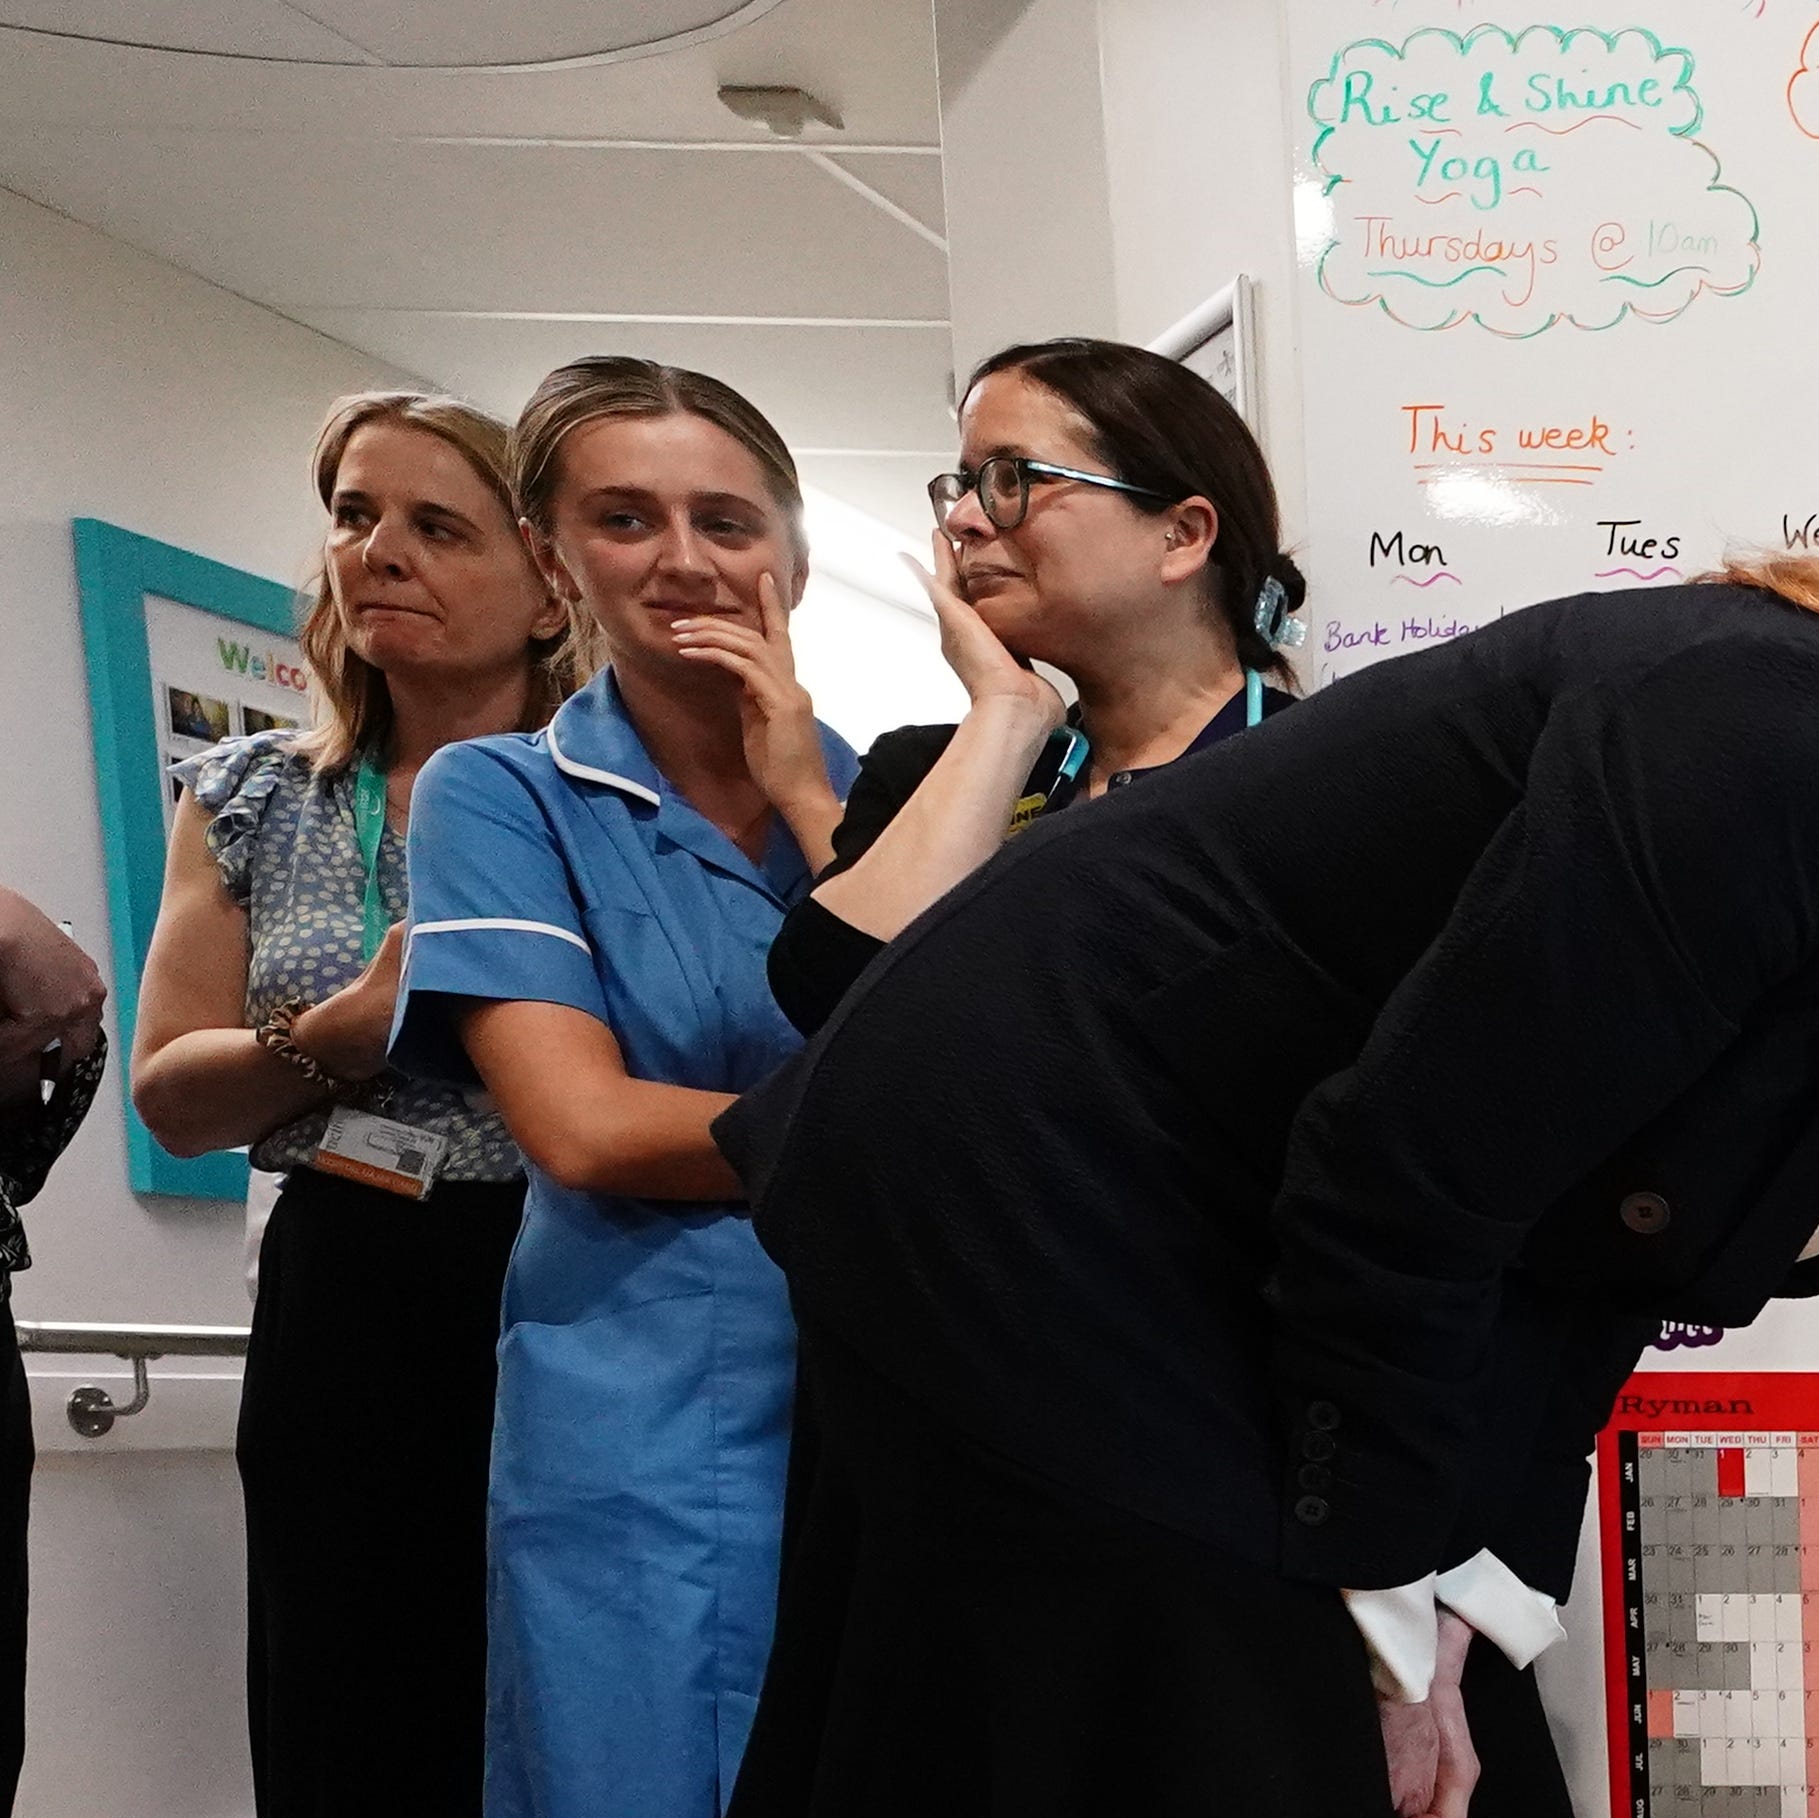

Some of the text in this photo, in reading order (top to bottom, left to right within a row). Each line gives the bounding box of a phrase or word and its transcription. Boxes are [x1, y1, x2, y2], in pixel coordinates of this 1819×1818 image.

[1341, 66, 1663, 126] Rise & Shine
[1408, 138, 1551, 211] Yoga
[1354, 217, 1719, 307] Thursdays @ 10am
[1401, 405, 1636, 456] This week:
[1369, 520, 1682, 568] Mon Tues
[1324, 613, 1480, 653] Bank Holida
[216, 636, 309, 692] Welco
[1619, 1395, 1755, 1419] Ryman
[1625, 1462, 1634, 1483] JAN
[1626, 1511, 1635, 1532] FEB
[1628, 1558, 1637, 1581] MAR
[1630, 1607, 1639, 1628] APR
[1632, 1655, 1641, 1677] MAY
[1634, 1703, 1643, 1724] JUN
[1635, 1752, 1644, 1772] JUL
